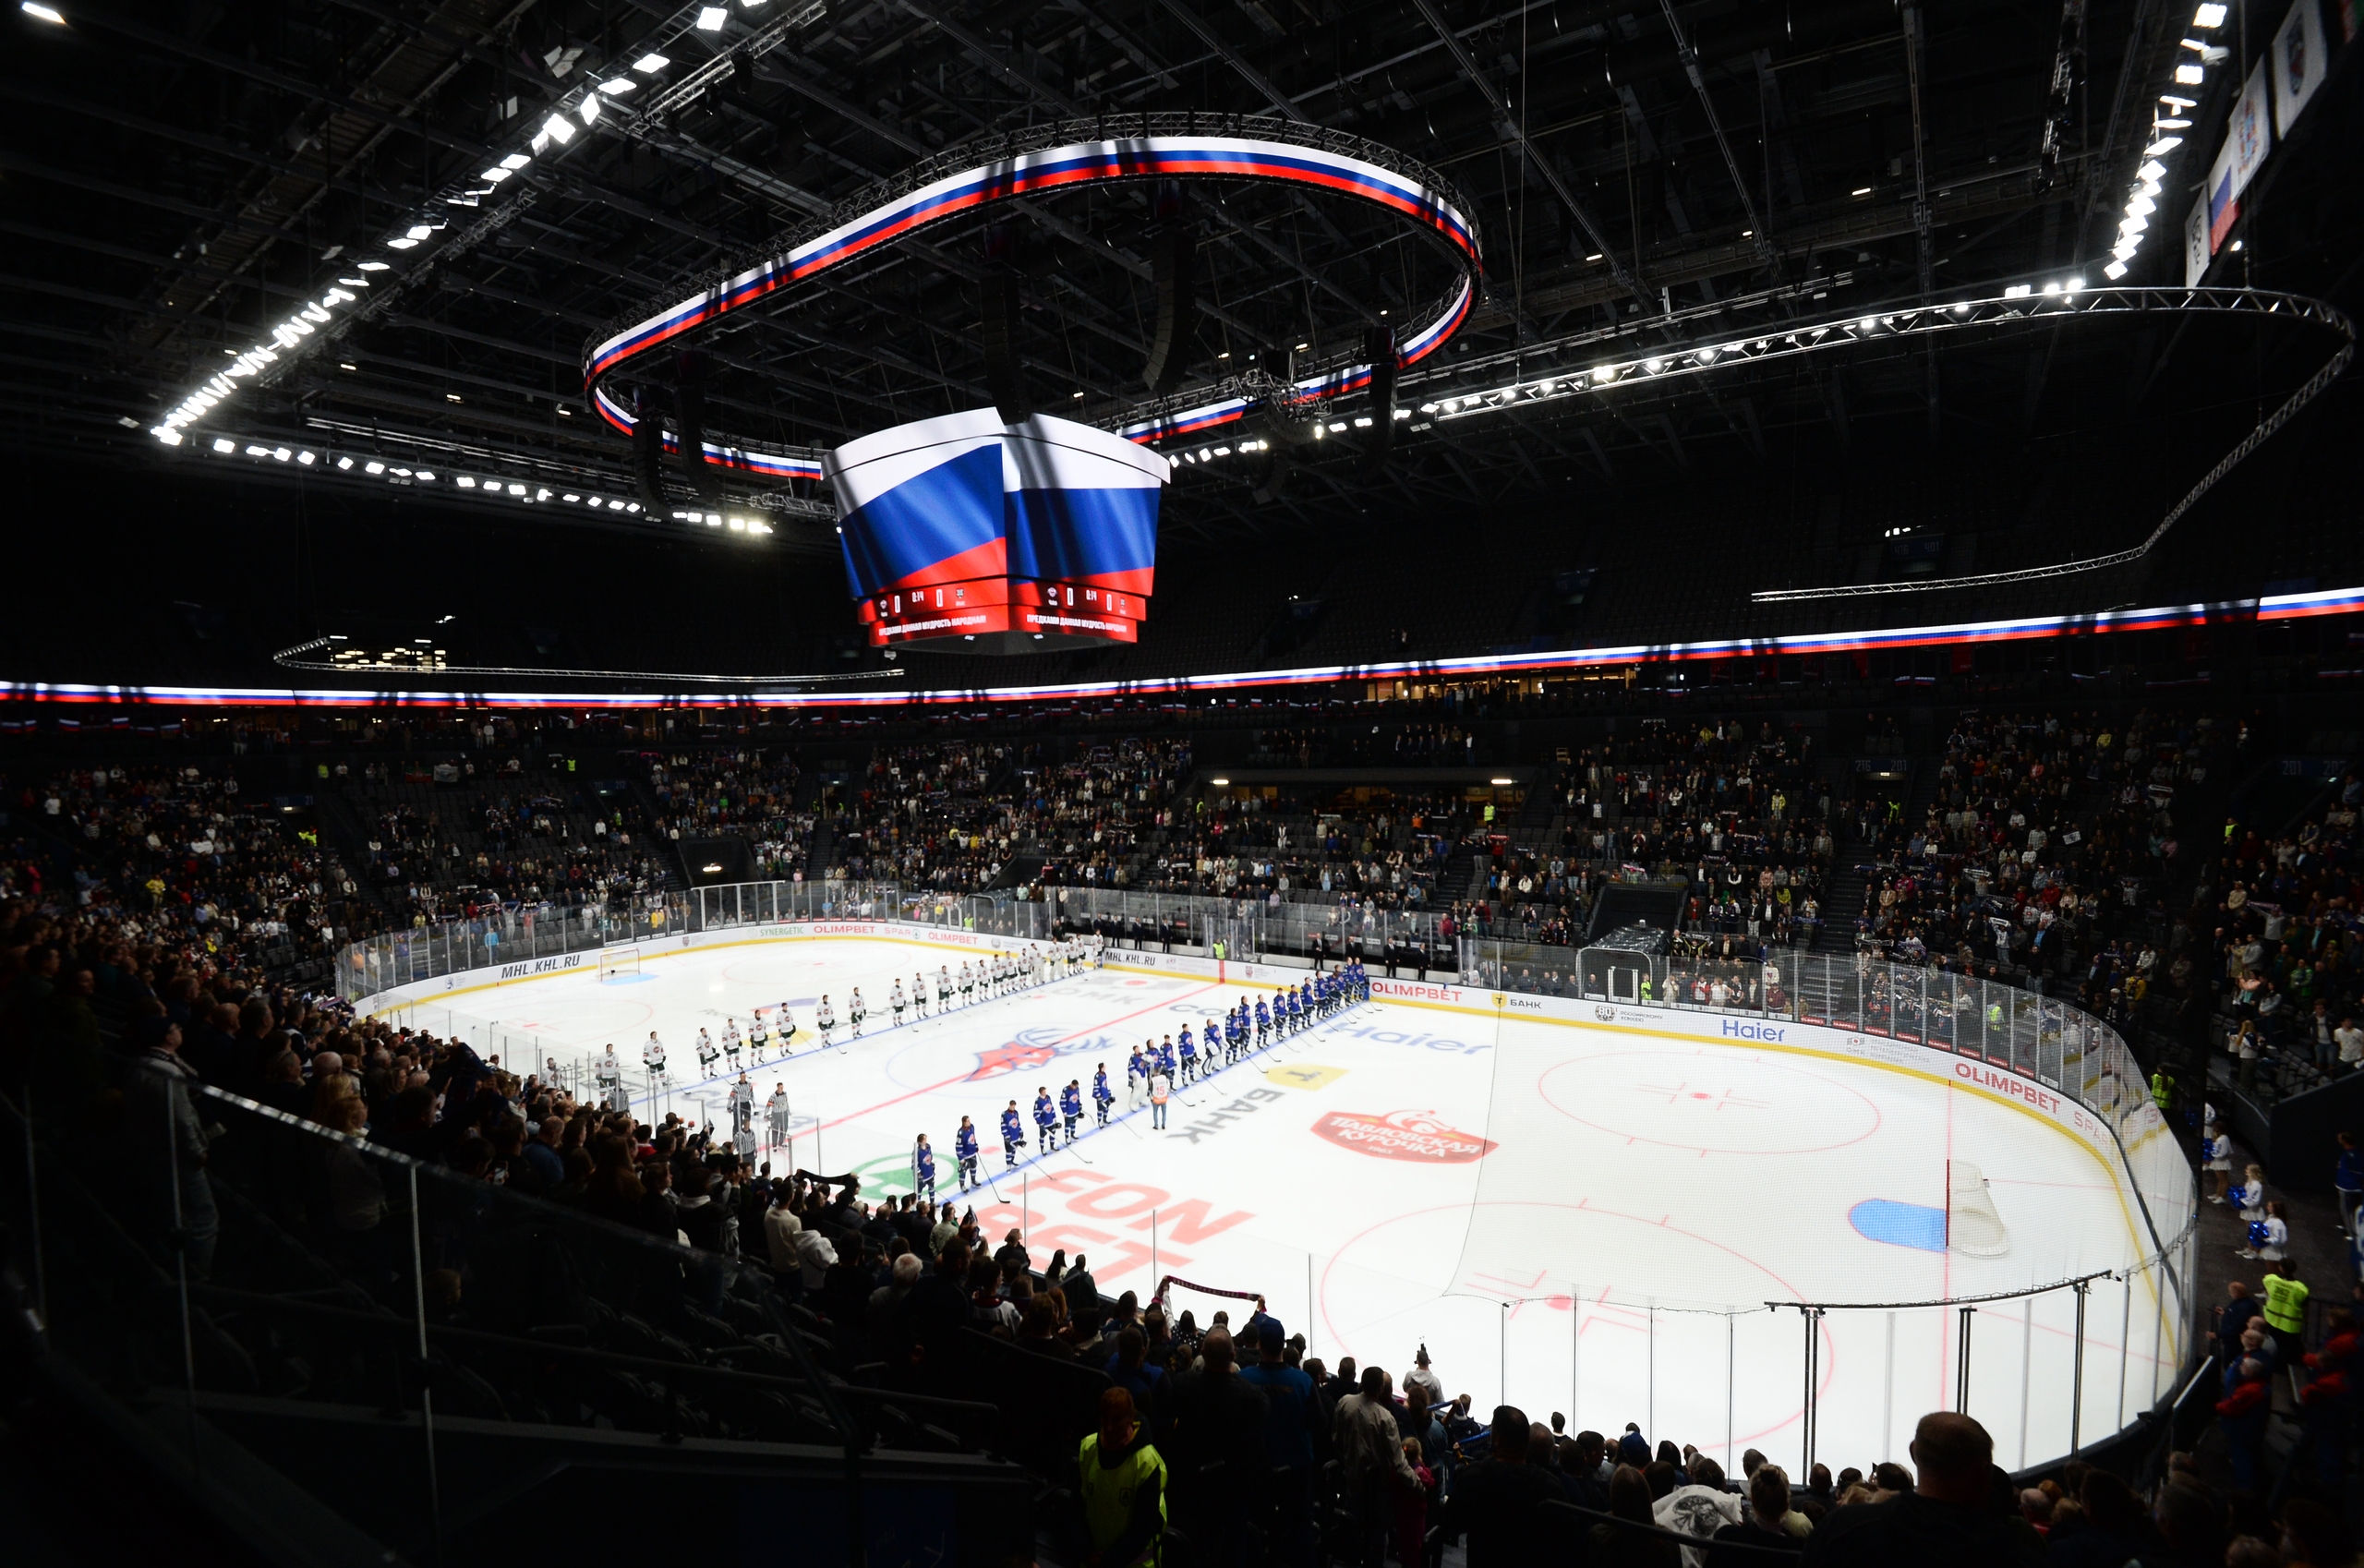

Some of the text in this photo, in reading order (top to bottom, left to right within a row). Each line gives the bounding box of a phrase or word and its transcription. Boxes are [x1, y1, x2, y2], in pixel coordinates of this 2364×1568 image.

[894, 595, 900, 613] 0
[935, 588, 943, 608] 0
[1067, 587, 1073, 606] 0
[1106, 594, 1112, 611] 0
[1027, 614, 1060, 625] ПРЕДКАМИ
[1855, 760, 1871, 771] 216
[1890, 760, 1907, 771] 201
[2282, 760, 2302, 776] 201
[760, 926, 803, 936] SYNERGETIC
[814, 925, 875, 934] OLIMPBET
[885, 927, 911, 935] SPAR
[928, 932, 978, 945] OLIMPBET
[501, 955, 580, 979] MHL.KHL.RU
[1105, 951, 1155, 966] MHL.KHL.RU
[1371, 982, 1462, 1002] OLIMPBET
[1510, 998, 1542, 1009] БАНК
[1323, 1023, 1492, 1055] Haier
[1722, 1019, 1785, 1043] Haier
[1156, 1086, 1164, 1096] 15
[1955, 1063, 2060, 1115] OLIMPBET
[1164, 1088, 1286, 1145] БАНК
[1330, 1116, 1481, 1153] ПАВЛОВСКАЯ
[1338, 1129, 1446, 1157] КУРОЧКА
[1004, 1169, 1258, 1246] FON
[975, 1202, 1195, 1286] BET
